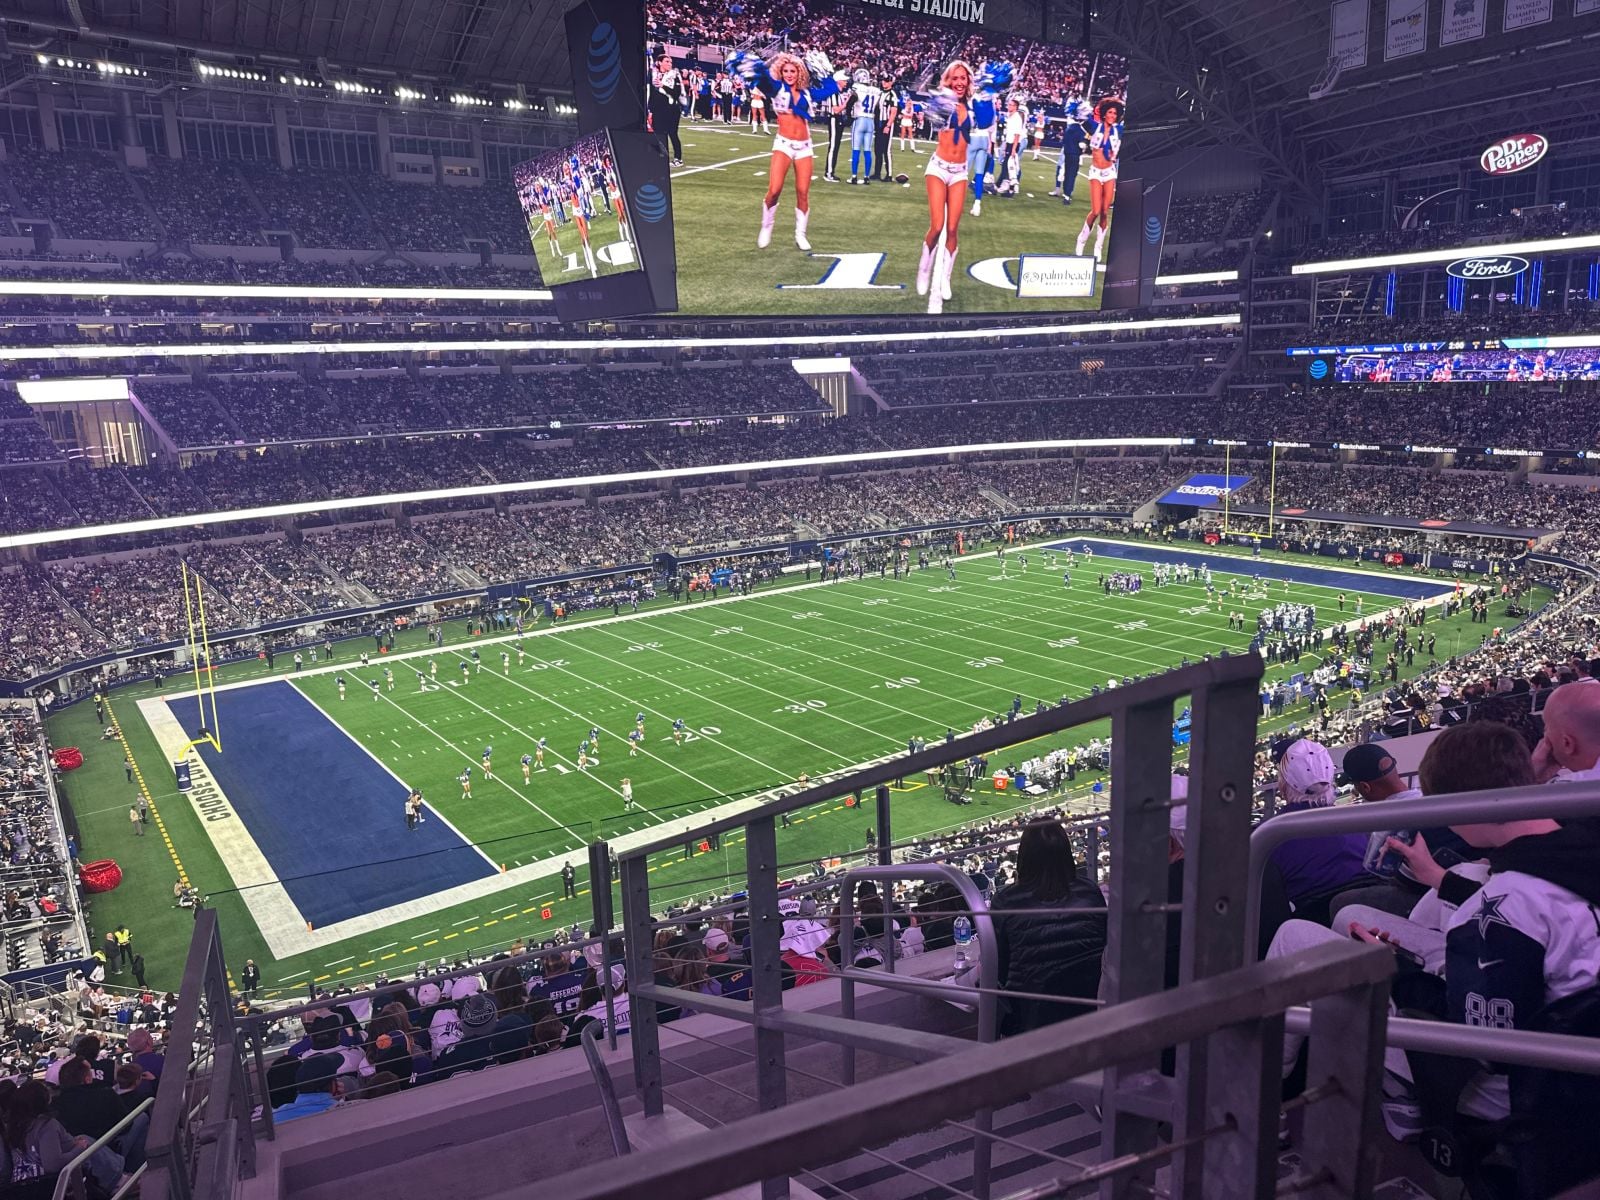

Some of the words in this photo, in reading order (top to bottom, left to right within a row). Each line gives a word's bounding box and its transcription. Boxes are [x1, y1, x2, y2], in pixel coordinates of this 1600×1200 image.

[911, 0, 985, 24] STADIUM
[1507, 7, 1549, 21] CHAMPIONS
[1444, 23, 1482, 36] CHAMPIONS
[862, 95, 875, 113] 41
[1502, 138, 1527, 157] Dr
[1486, 141, 1543, 173] Pepper
[1462, 258, 1512, 277] Ford
[1041, 269, 1063, 283] palm
[1065, 269, 1091, 281] beach
[1411, 445, 1457, 453] Blockchain.com
[1492, 448, 1544, 457] Blockchain.com
[531, 659, 571, 670] 20
[965, 656, 1004, 668] 50
[884, 677, 921, 689] 40
[784, 700, 828, 714] 30
[681, 726, 722, 743] 20
[191, 781, 232, 822] CHOOSE
[1465, 991, 1515, 1030] 88
[1431, 1138, 1452, 1167] 13
